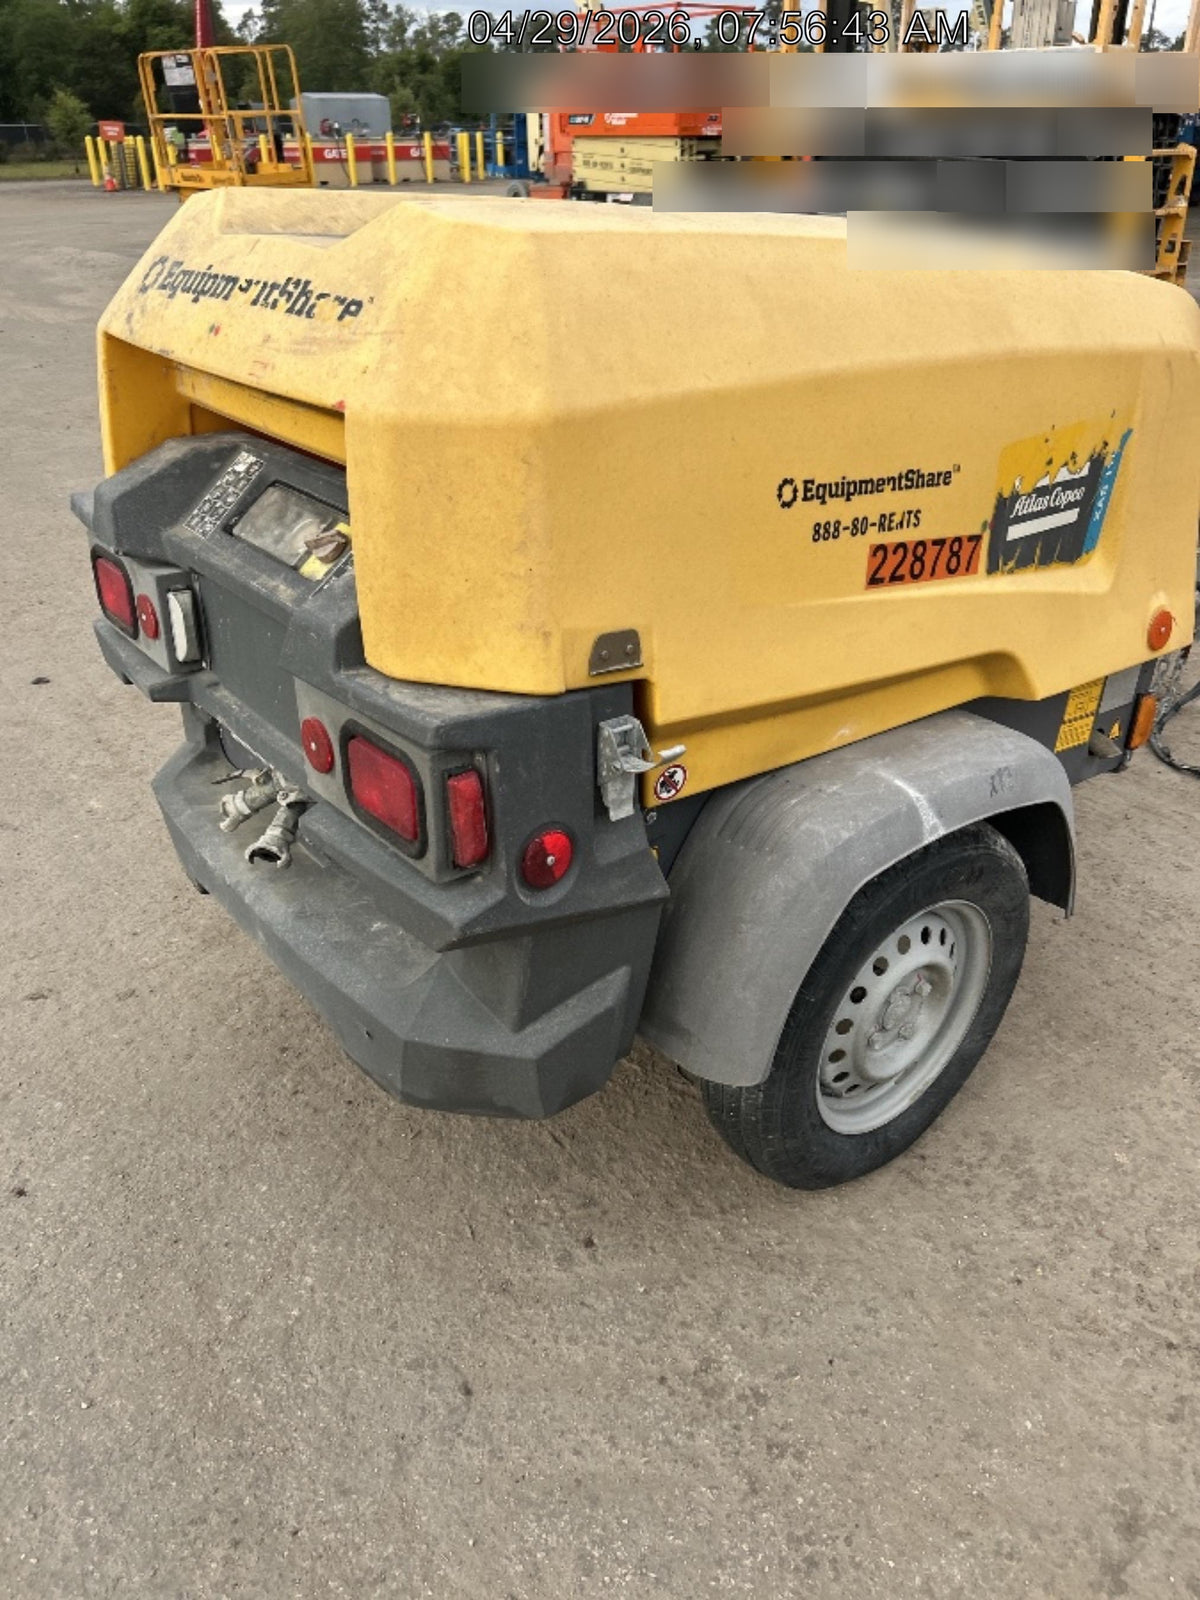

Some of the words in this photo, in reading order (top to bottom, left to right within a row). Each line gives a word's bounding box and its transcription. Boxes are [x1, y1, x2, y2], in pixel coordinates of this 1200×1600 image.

[802, 468, 953, 505] EquipmentShare
[1009, 493, 1050, 519] Atlas
[1049, 486, 1087, 509] Copco
[867, 535, 983, 586] 228787
